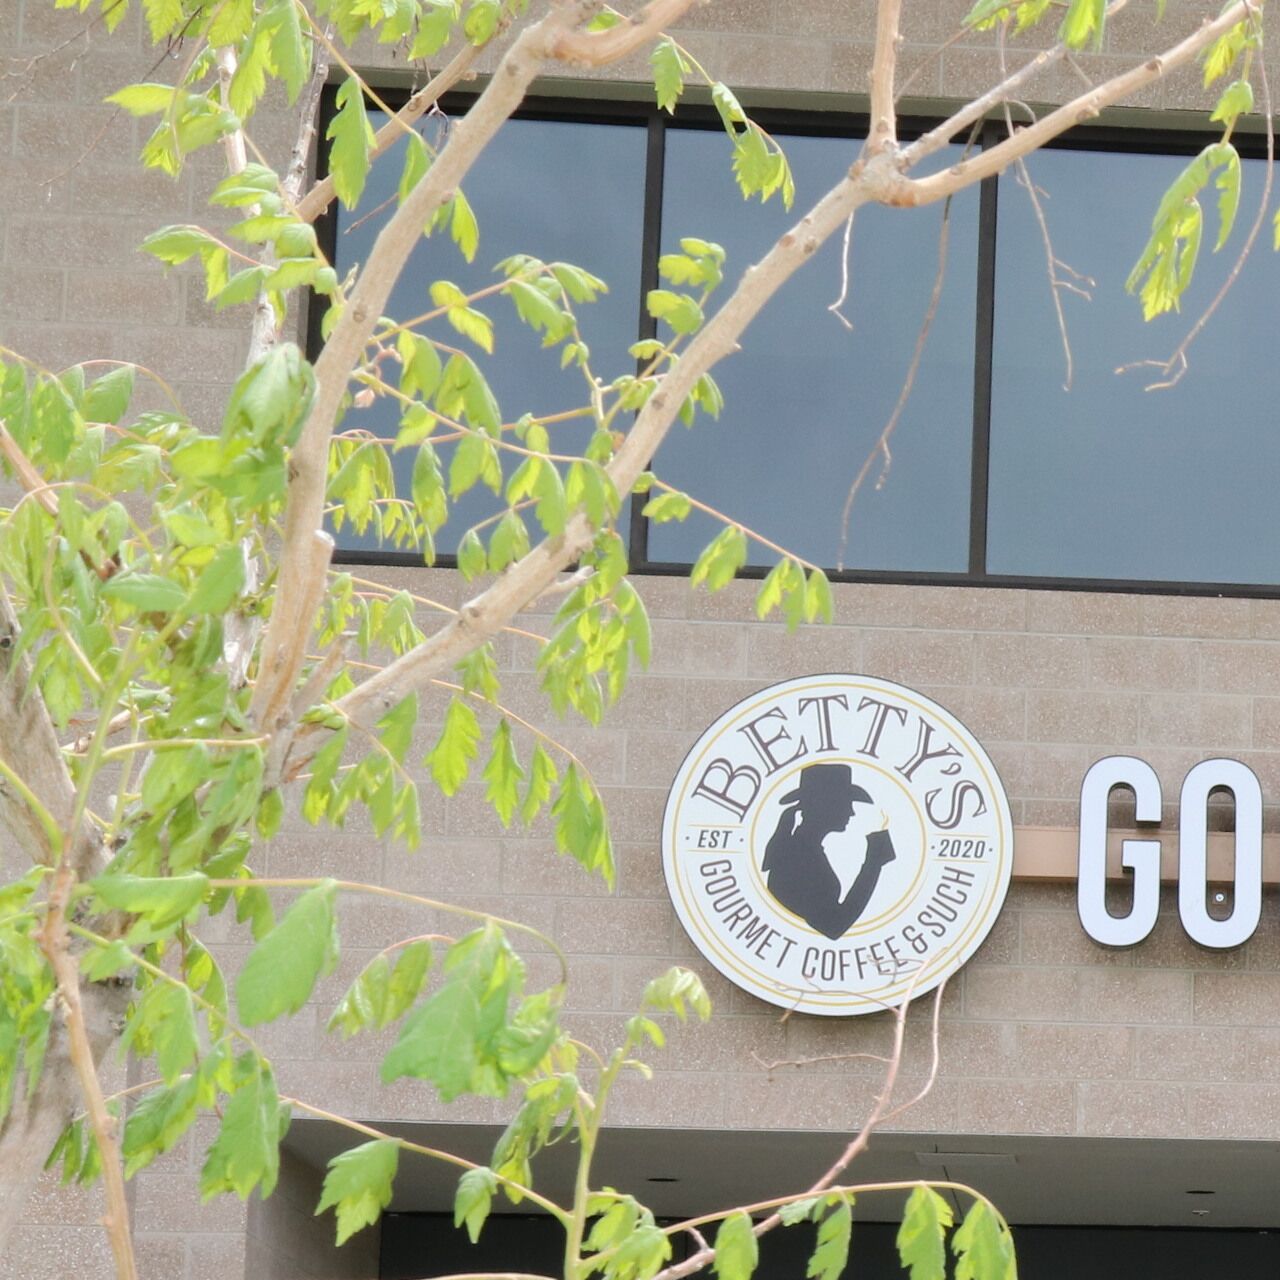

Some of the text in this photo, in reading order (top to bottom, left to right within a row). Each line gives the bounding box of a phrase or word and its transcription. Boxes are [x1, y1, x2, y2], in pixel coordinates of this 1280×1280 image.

[691, 694, 987, 829] BETTY'S
[697, 830, 733, 849] EST
[938, 839, 986, 859] 2020
[700, 859, 798, 968] GOURMET
[801, 935, 908, 981] COFFEE
[917, 866, 975, 937] SUCH
